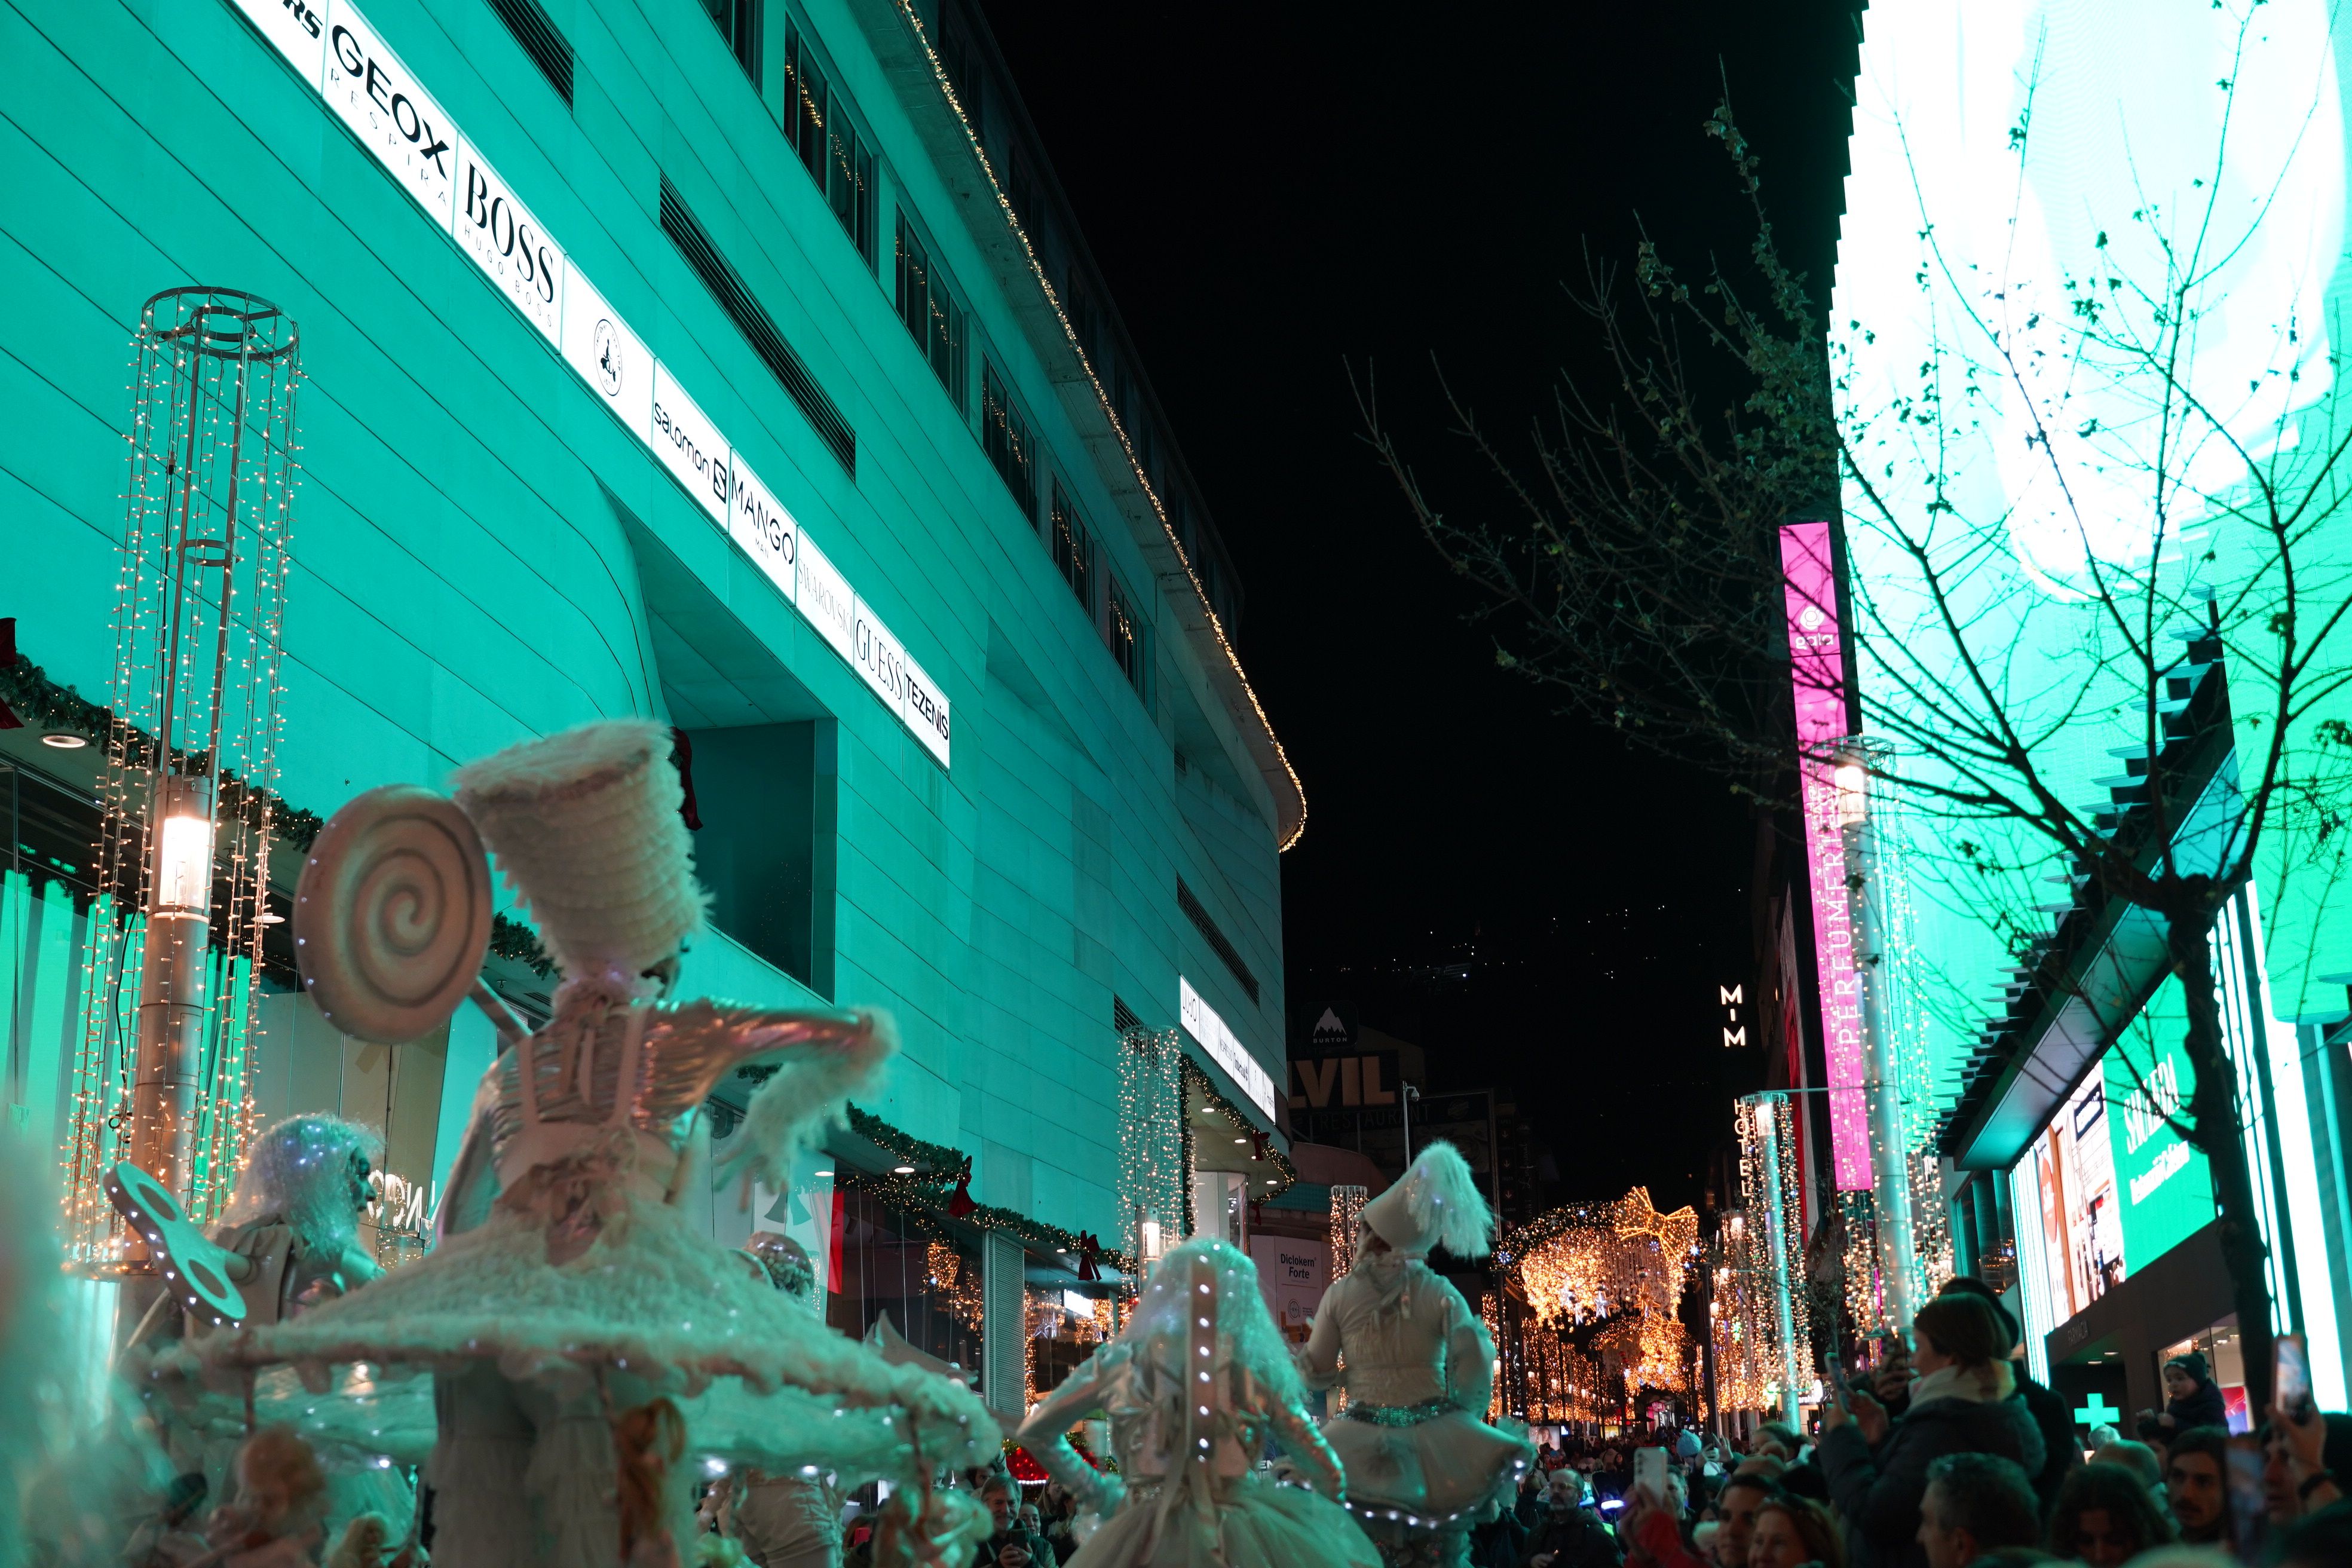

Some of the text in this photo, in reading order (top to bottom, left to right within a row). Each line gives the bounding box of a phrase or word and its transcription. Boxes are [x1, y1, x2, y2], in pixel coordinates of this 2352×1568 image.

[330, 68, 446, 206] RESPIRA
[332, 24, 449, 181] GEOX
[465, 160, 553, 303] BOSS
[465, 225, 552, 327] HUGO BOSS
[654, 402, 709, 480] salomon
[731, 470, 794, 565] MANGO
[755, 537, 769, 559] MAN
[798, 558, 852, 638] SWAROVSKI
[856, 619, 902, 700] GUESS
[1720, 984, 1745, 1047] MIM
[1281, 1253, 1315, 1267] Diclokern
[1288, 1267, 1310, 1279] Forte
